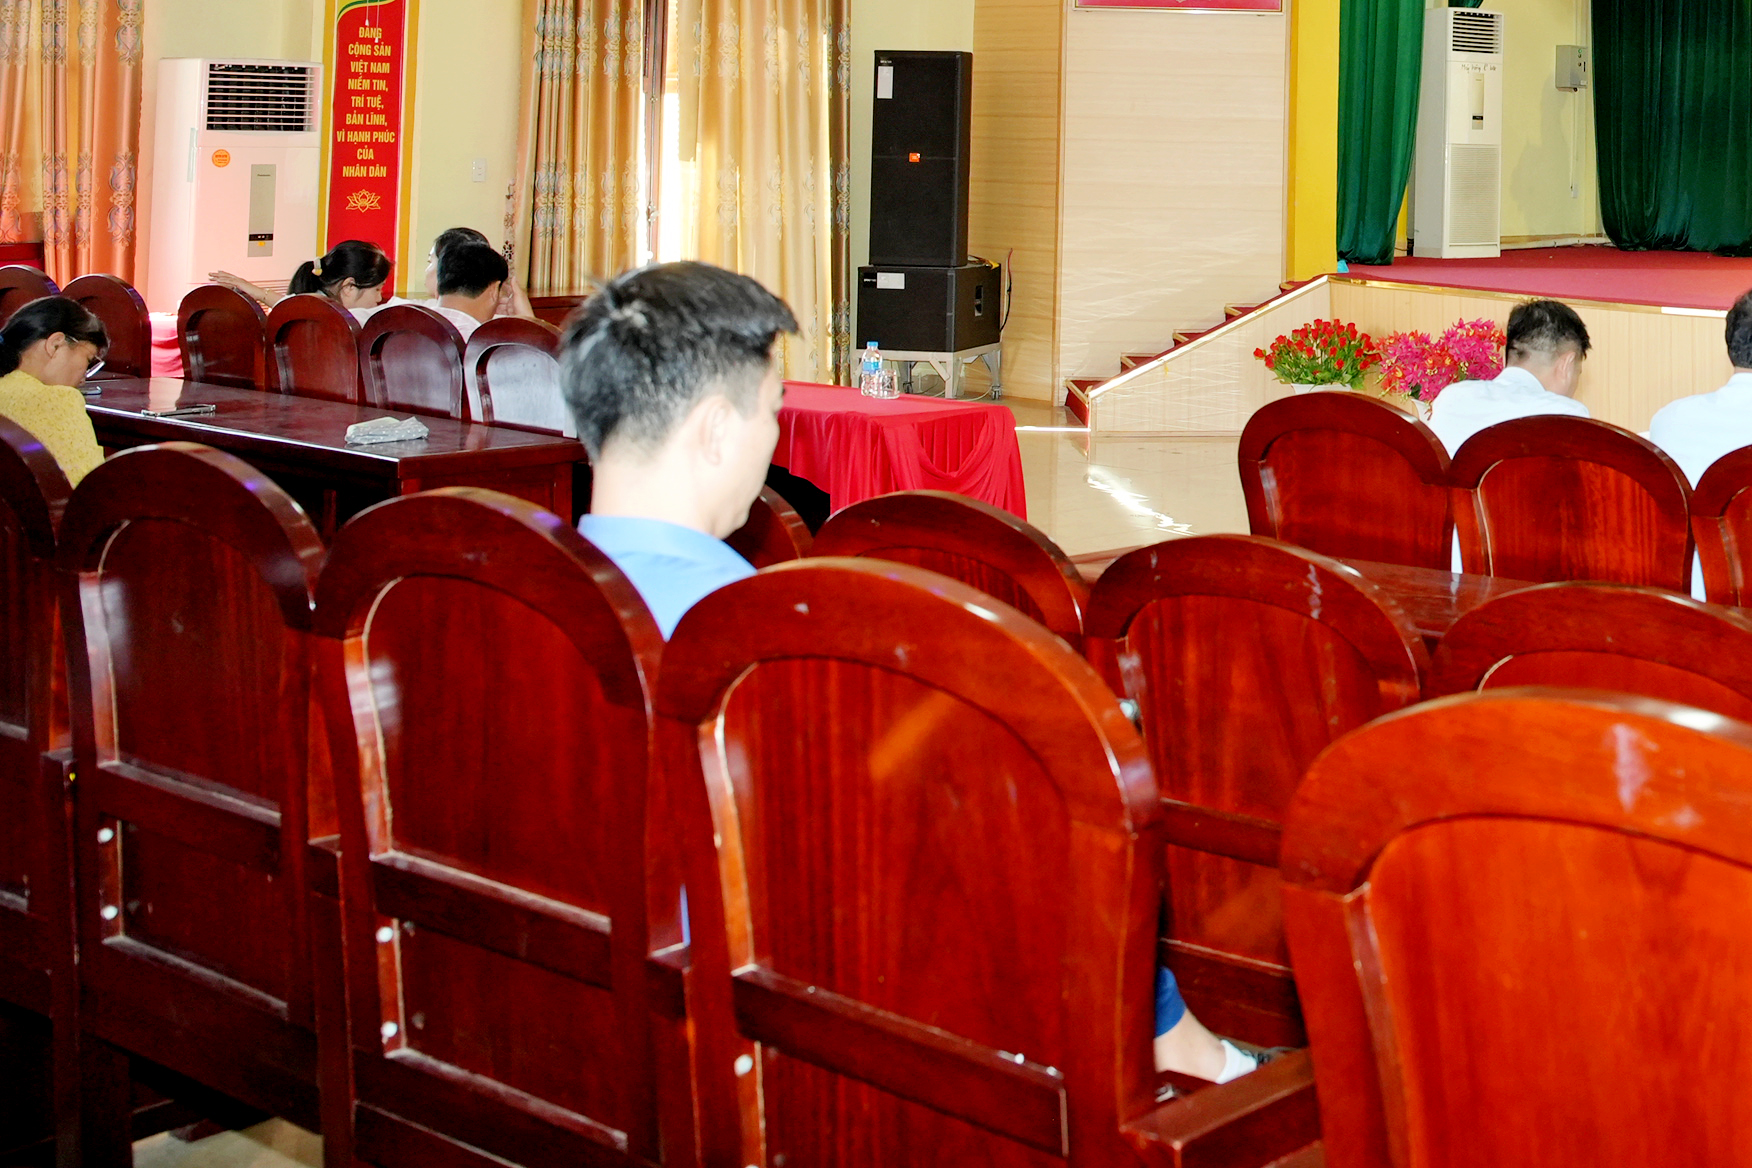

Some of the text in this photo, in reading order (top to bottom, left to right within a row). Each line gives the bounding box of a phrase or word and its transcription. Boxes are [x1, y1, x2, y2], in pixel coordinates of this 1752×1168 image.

[348, 41, 391, 57] CỘNG SẢN
[350, 59, 390, 75] VIỆT NAM
[351, 94, 364, 108] TRÍ
[337, 128, 395, 145] VÌ HẠNH PHÚC
[357, 145, 374, 160] CỦA
[342, 164, 386, 178] NHÂN DÂN
